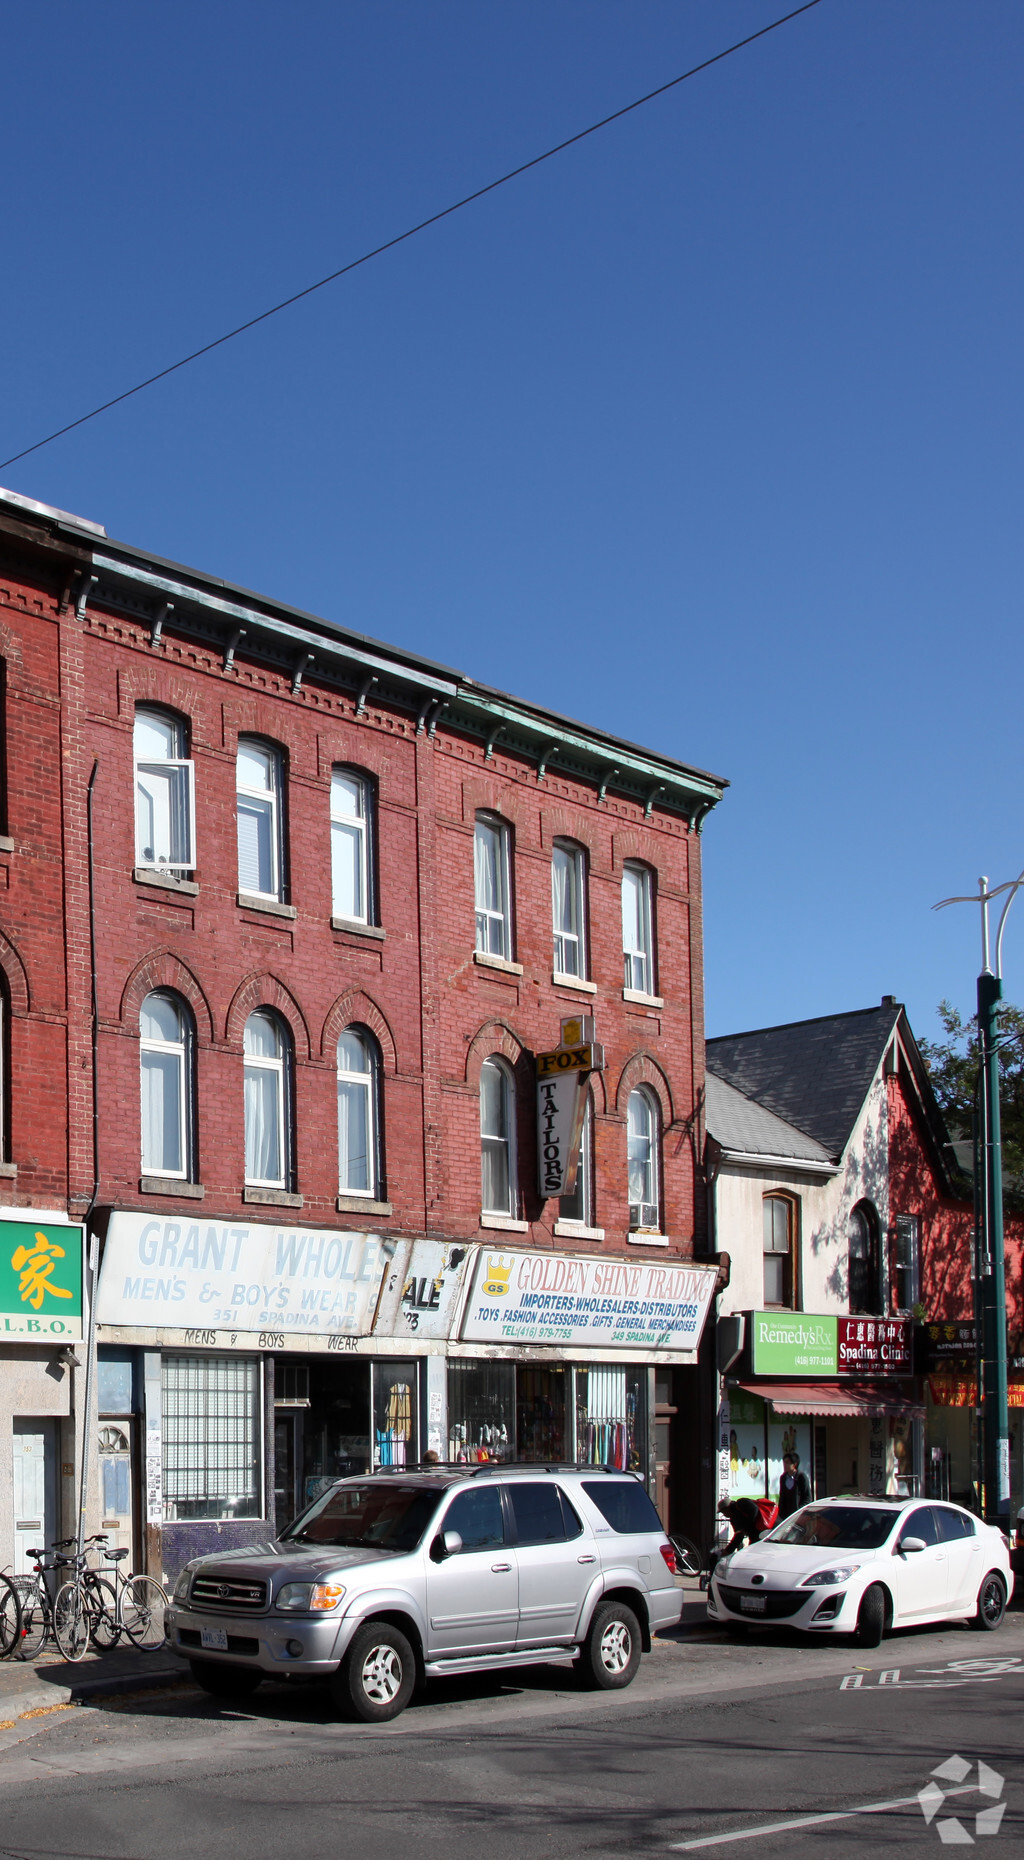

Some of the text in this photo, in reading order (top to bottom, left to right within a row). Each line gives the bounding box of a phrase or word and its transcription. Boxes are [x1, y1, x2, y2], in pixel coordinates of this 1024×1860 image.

[540, 1049, 589, 1072] FOX
[540, 1083, 564, 1192] TAILORS
[138, 1221, 250, 1273] GRANT
[487, 1284, 504, 1293] GS
[517, 1257, 712, 1302] GOLDEN SHINE TRADING
[122, 1275, 187, 1301] MEN'S
[199, 1282, 222, 1304] &
[230, 1281, 290, 1309] BOY'S
[301, 1288, 358, 1313] WEAR
[213, 1309, 358, 1328] 351 SPADINA AVE.
[538, 1312, 590, 1327] ACCESSORIES
[647, 1319, 697, 1332] MERCHANDISES
[184, 1330, 217, 1345] MENS
[258, 1334, 285, 1348] BOYS
[328, 1336, 359, 1352] WEAR
[538, 1327, 573, 1339] 979-7755
[611, 1331, 625, 1341] 349
[625, 1332, 655, 1342] SPADINA
[794, 1356, 834, 1367] (416) 977-1101
[839, 1343, 910, 1362] Spadina Clinic
